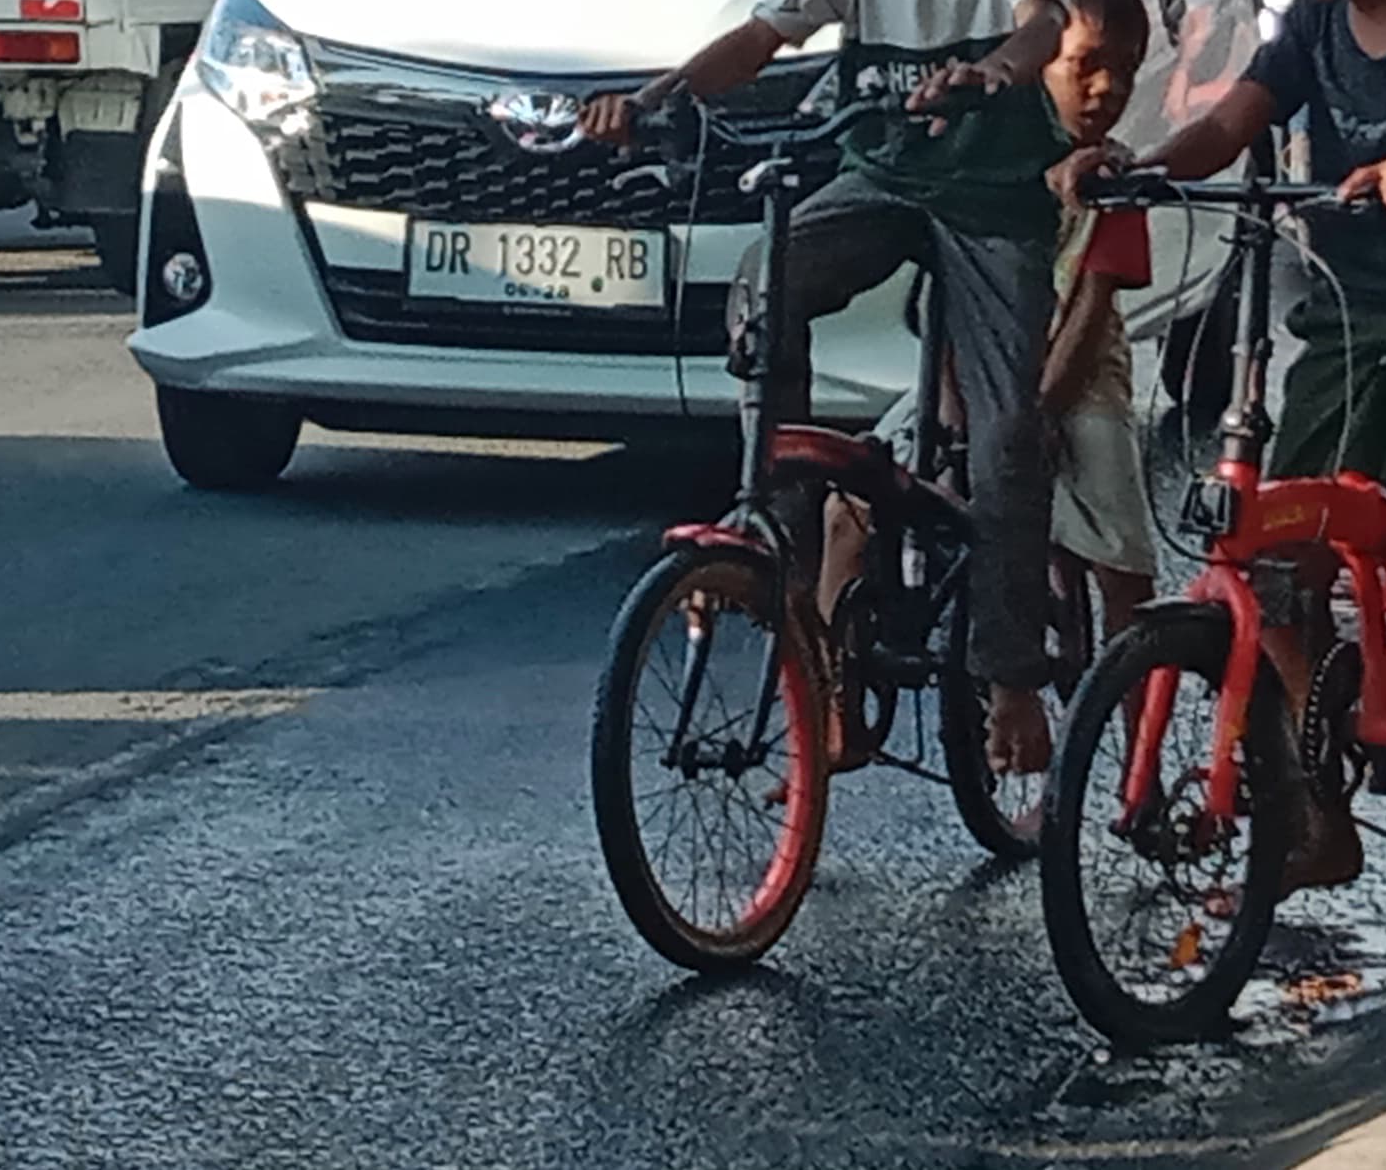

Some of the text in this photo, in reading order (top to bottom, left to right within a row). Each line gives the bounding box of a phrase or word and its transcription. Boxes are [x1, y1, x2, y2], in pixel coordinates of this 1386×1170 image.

[425, 230, 649, 281] DR 1332 RB
